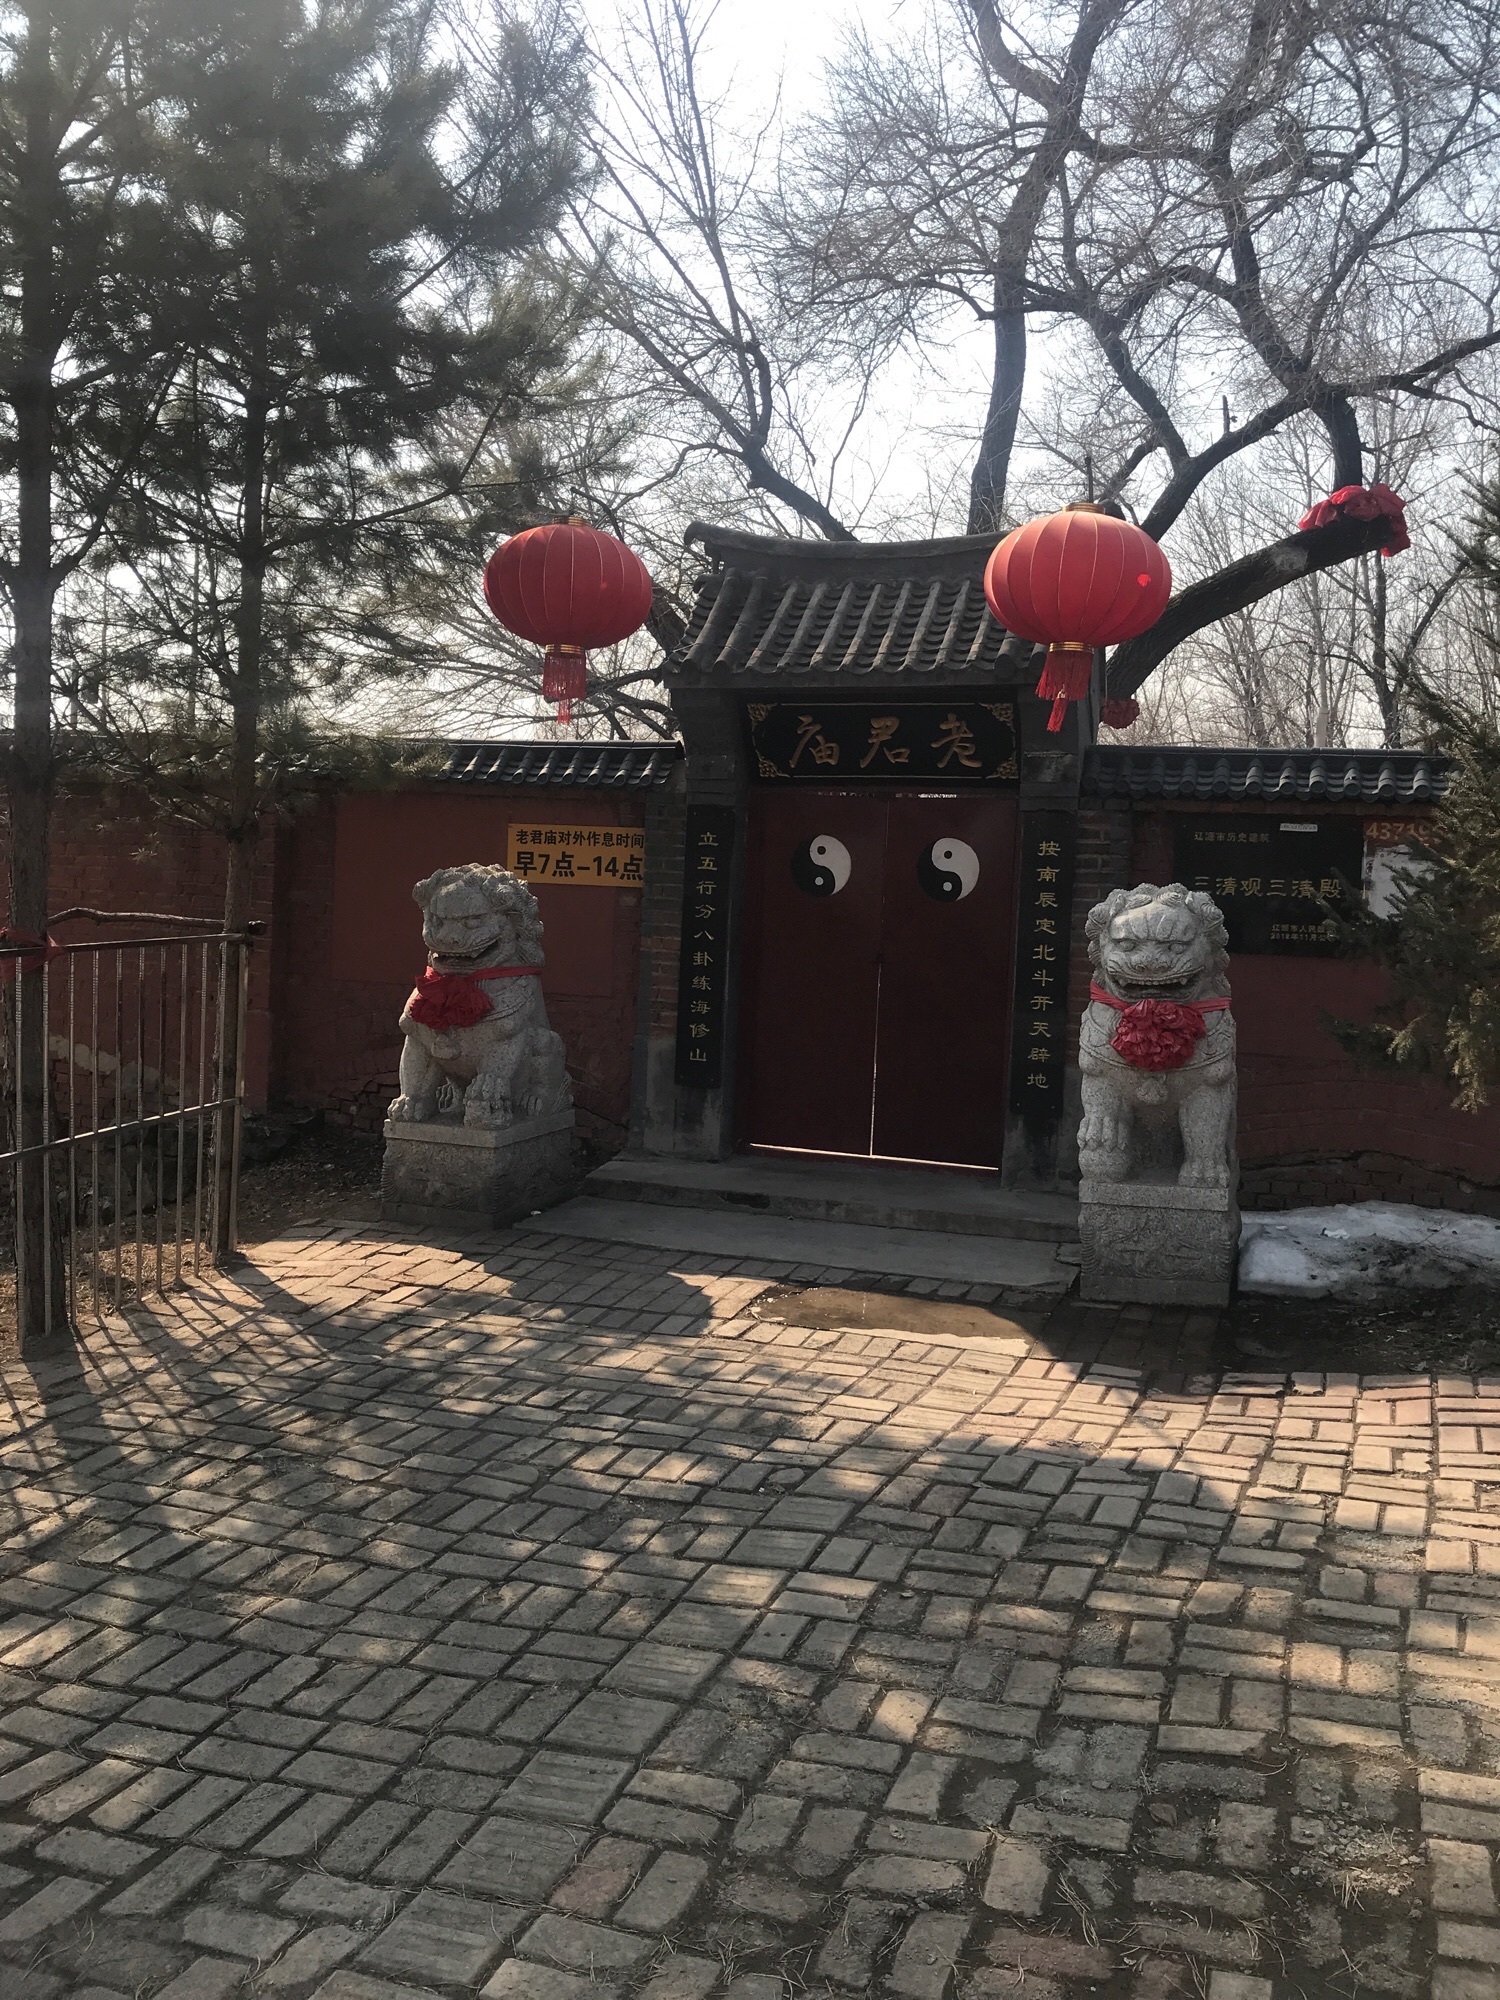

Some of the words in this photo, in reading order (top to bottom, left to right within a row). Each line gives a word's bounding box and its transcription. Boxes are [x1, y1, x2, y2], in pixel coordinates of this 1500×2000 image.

[789, 713, 982, 768] 老君庙
[516, 829, 645, 848] 老君庙对外作息时间
[1194, 875, 1342, 899] 三清观三清殿
[690, 832, 719, 1062] 立五行分八卦练海修山
[1027, 840, 1061, 1088] 按南辰定北斗开天辟地
